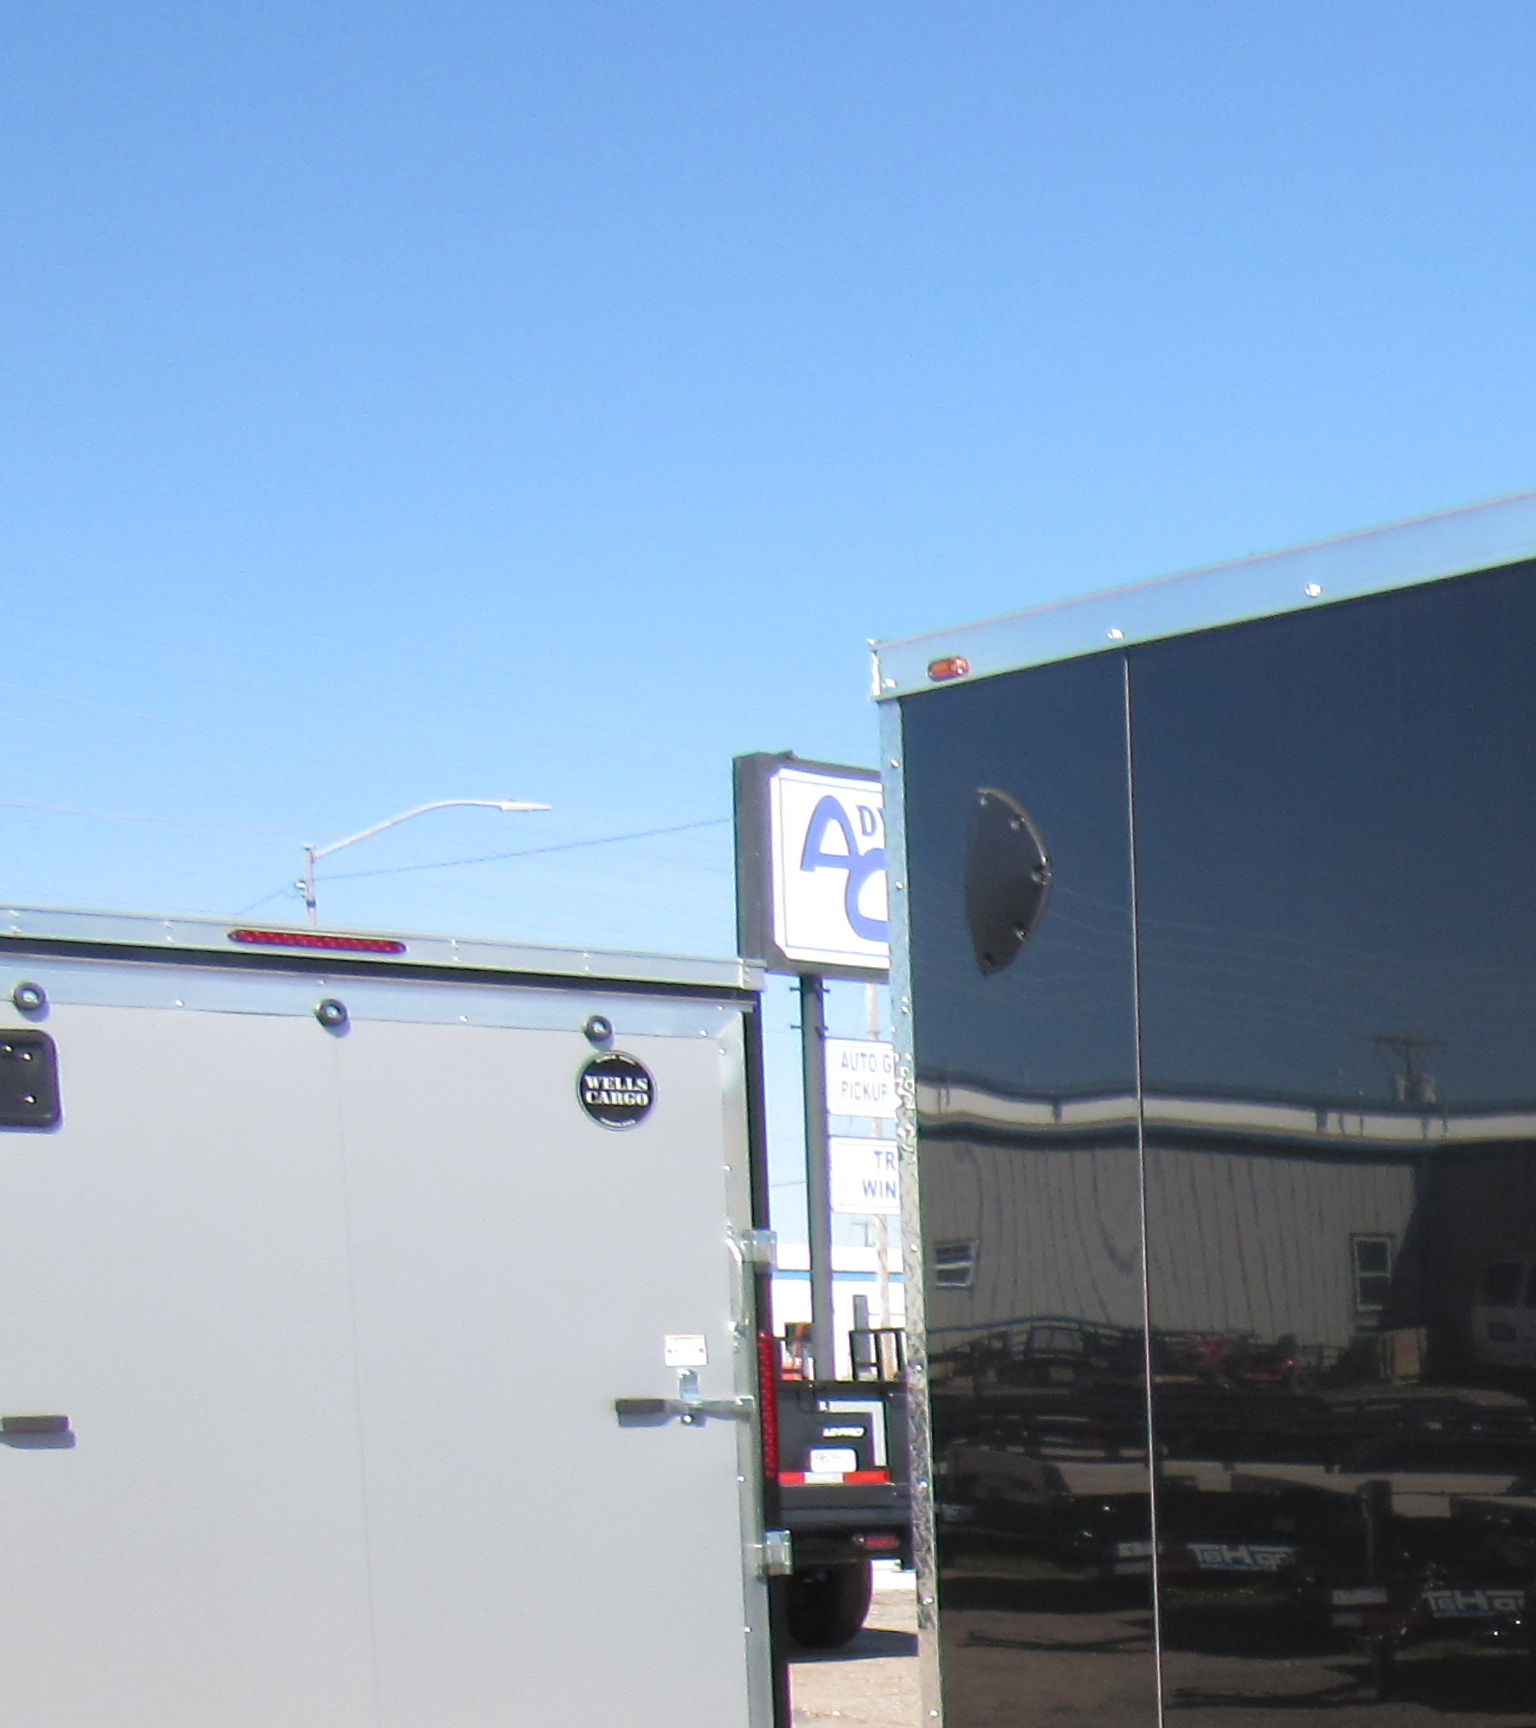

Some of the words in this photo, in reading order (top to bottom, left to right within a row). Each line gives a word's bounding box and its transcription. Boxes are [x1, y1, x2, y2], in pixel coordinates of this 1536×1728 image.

[841, 1051, 877, 1072] AUTO
[584, 1075, 649, 1091] WELLS
[841, 1080, 888, 1101] PICKUP
[585, 1090, 650, 1106] CARGO
